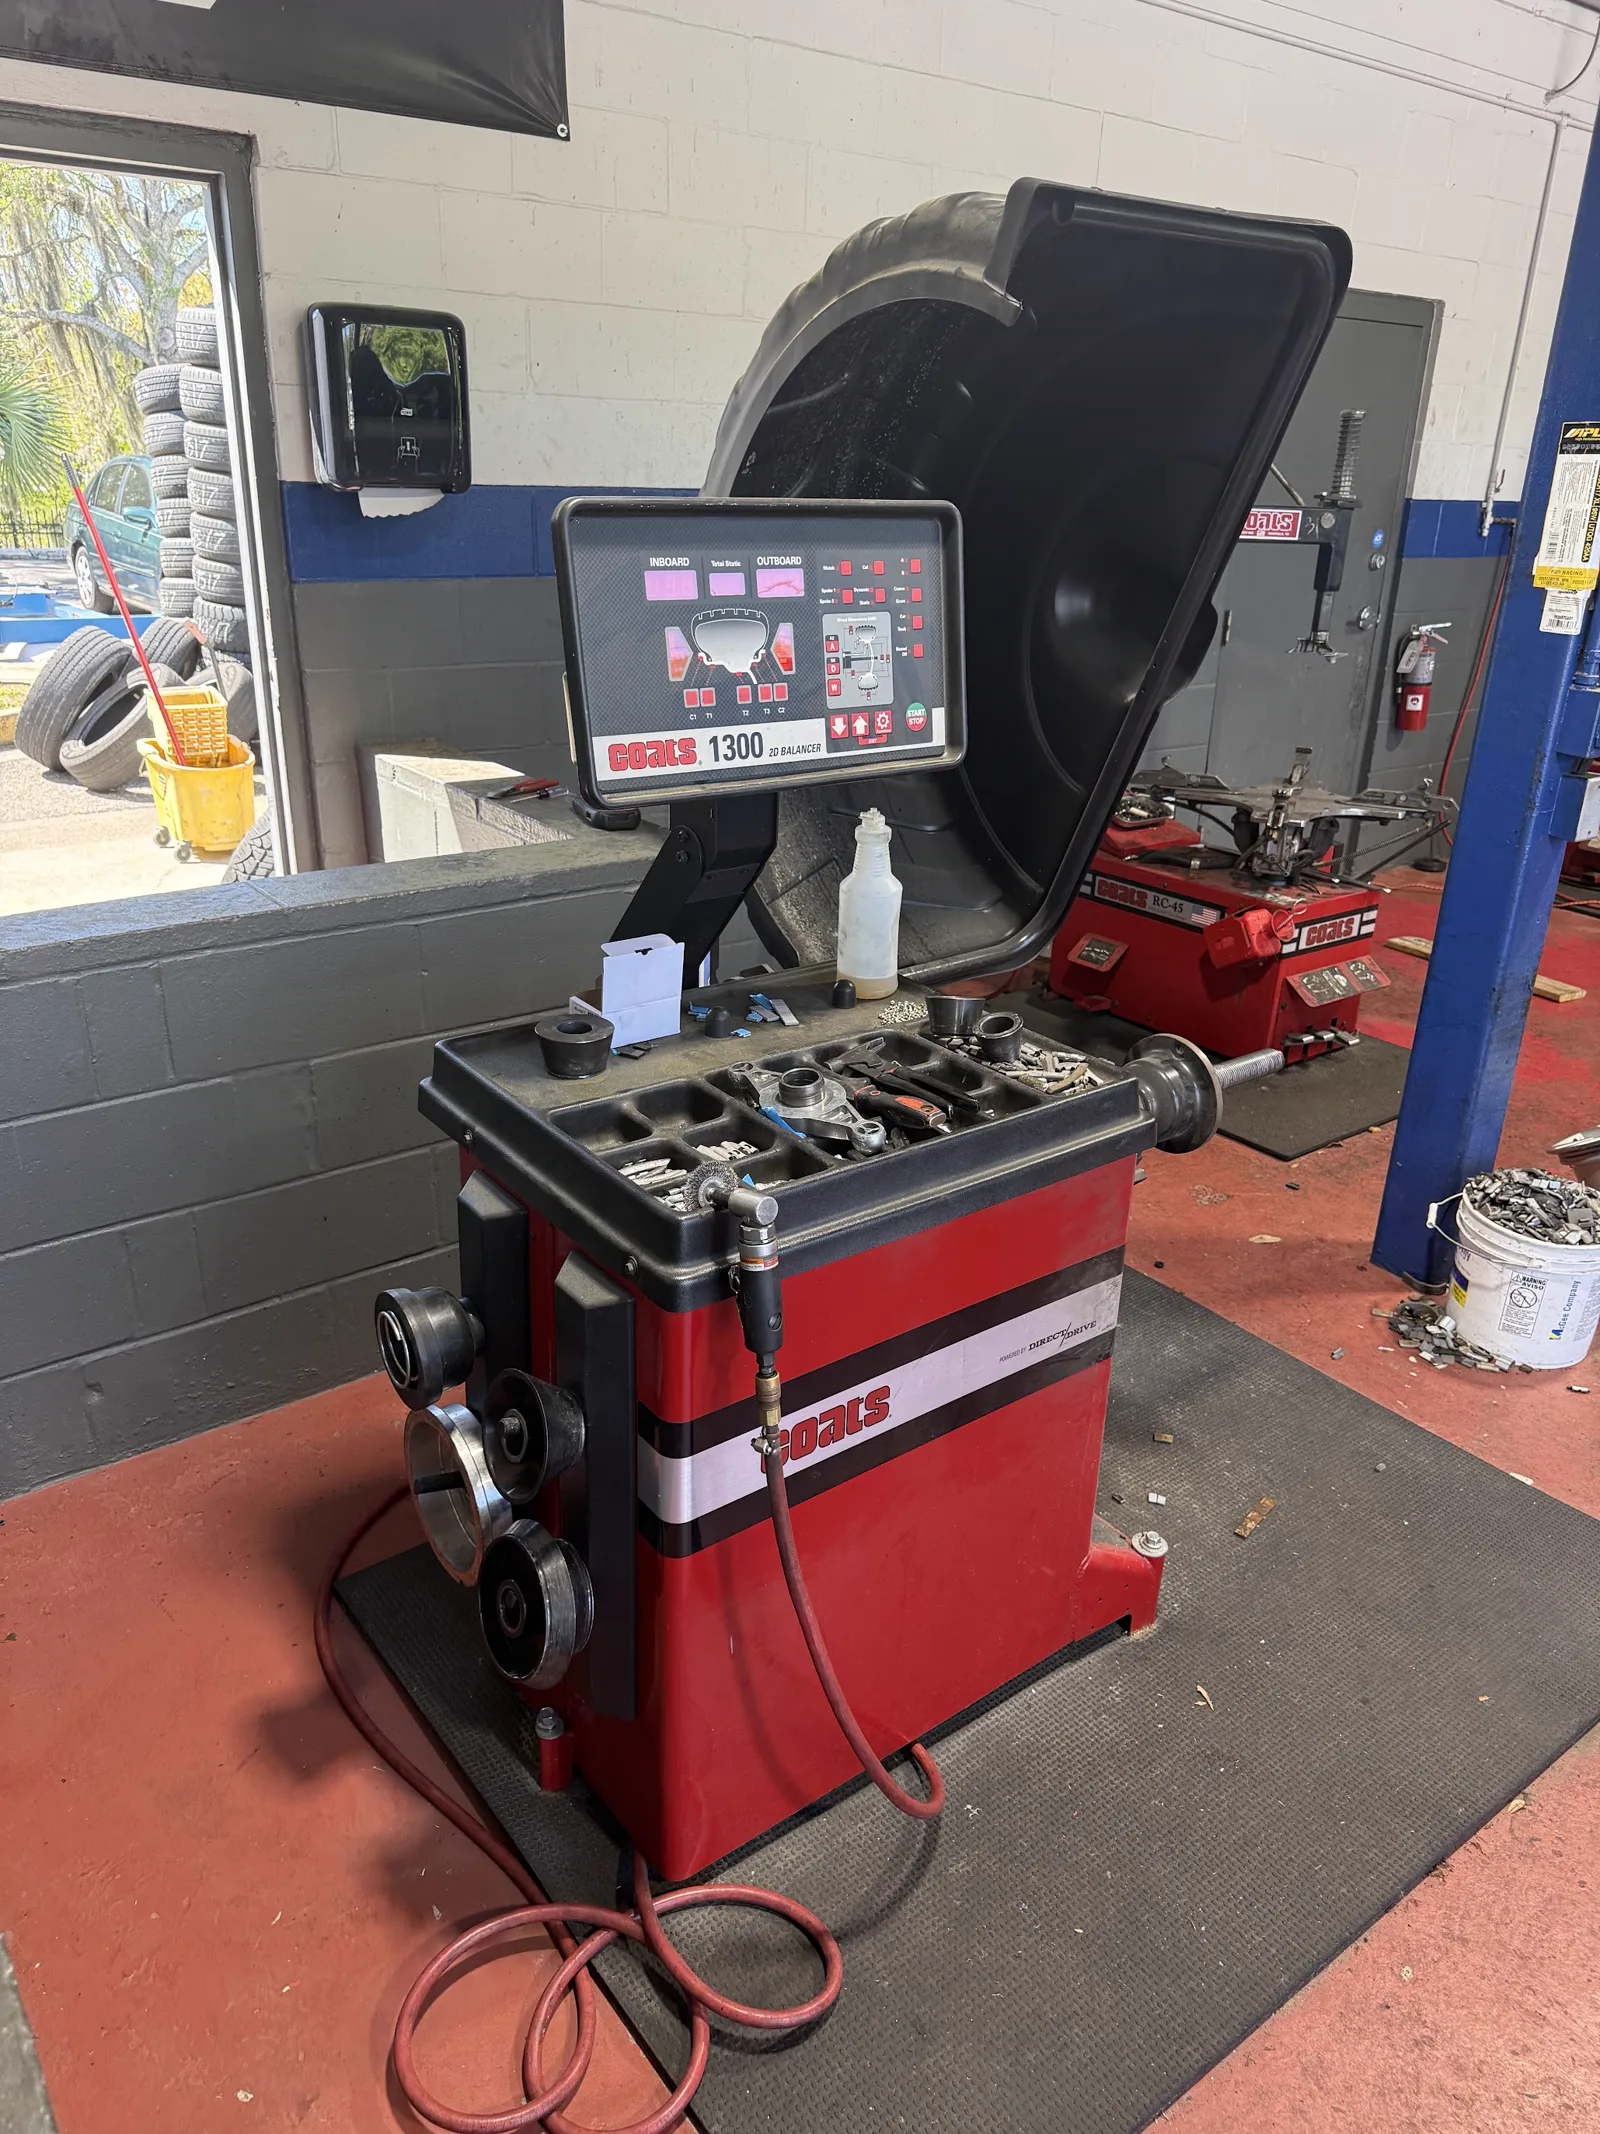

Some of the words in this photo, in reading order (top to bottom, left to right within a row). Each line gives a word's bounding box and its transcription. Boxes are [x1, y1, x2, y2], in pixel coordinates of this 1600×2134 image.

[1246, 512, 1293, 531] oats
[649, 557, 690, 567] INBOARD
[757, 556, 802, 566] OUTBOARD
[907, 708, 925, 717] START
[908, 717, 925, 725] STOP
[708, 731, 764, 763] 1300
[769, 747, 779, 758] 2D
[780, 743, 822, 756] BALANCER
[1152, 894, 1184, 913] RC-45
[1521, 1275, 1546, 1286] WARNING
[1521, 1282, 1545, 1291] AVISO
[1563, 1280, 1582, 1312] Company
[999, 1349, 1020, 1363] POWERED
[1020, 1346, 1027, 1355] BY
